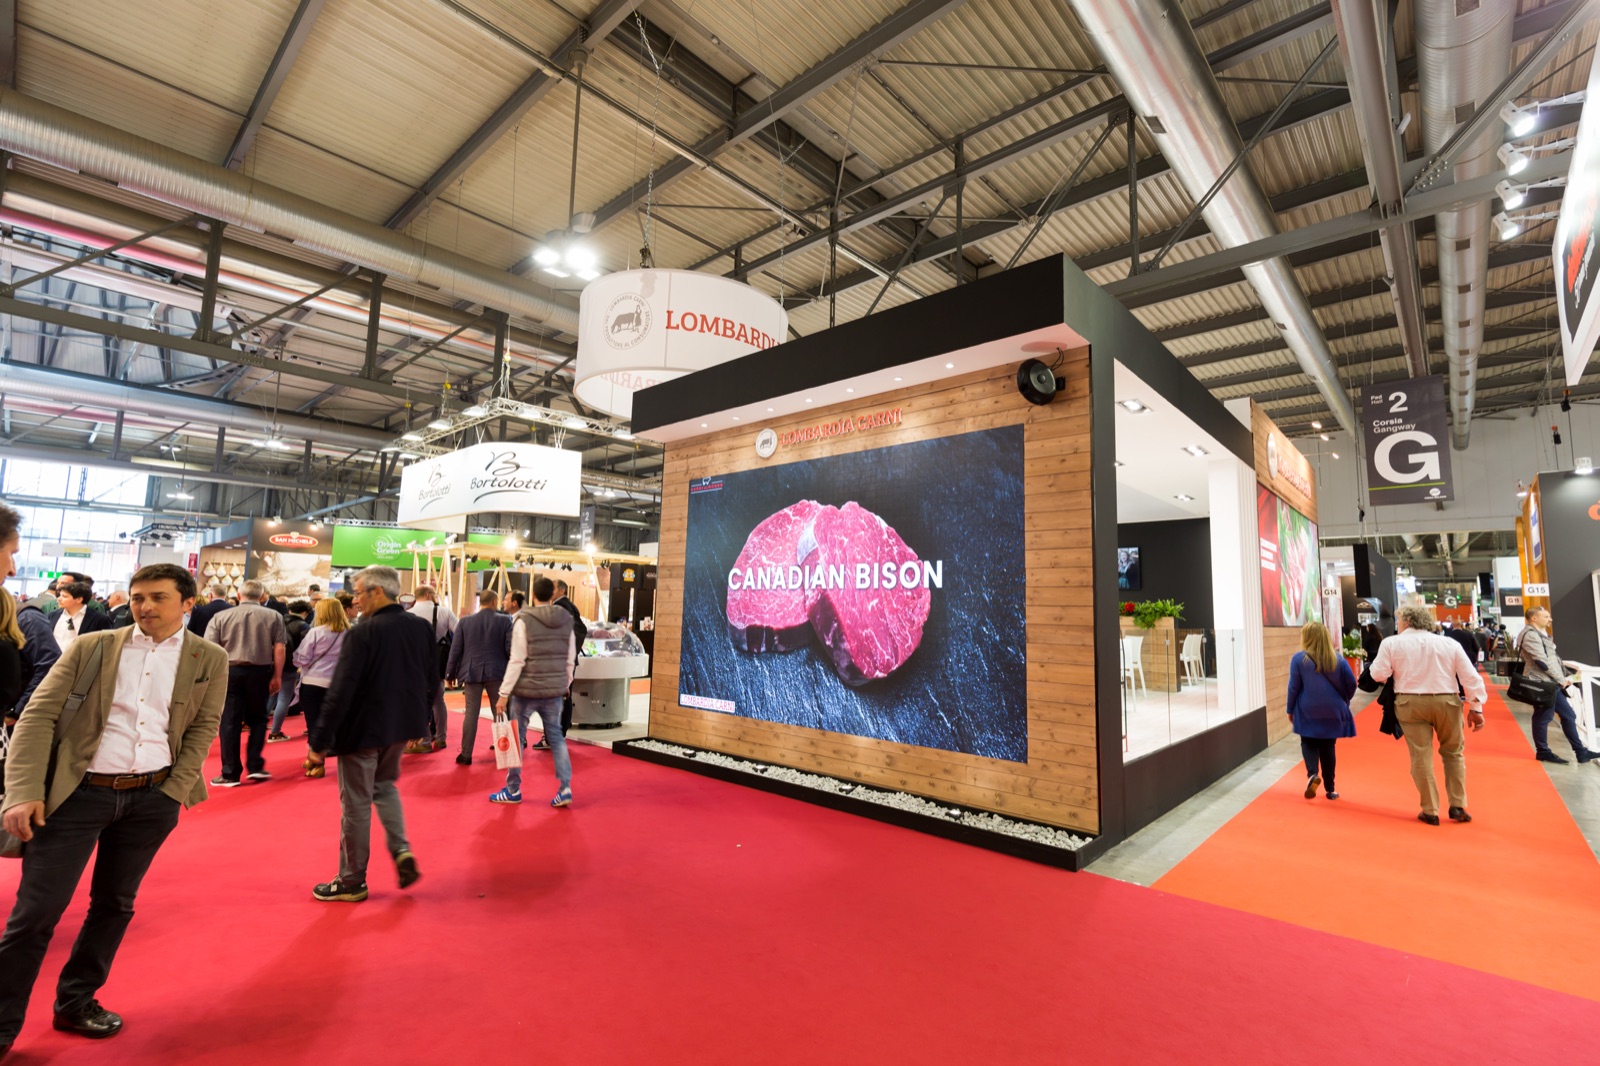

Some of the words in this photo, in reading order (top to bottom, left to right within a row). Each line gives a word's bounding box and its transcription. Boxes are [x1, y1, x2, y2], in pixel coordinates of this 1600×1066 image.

[665, 310, 781, 351] LOMBARDI
[1388, 391, 1408, 413] 2
[856, 408, 902, 431] CARNI
[1373, 417, 1403, 427] Corsia
[1373, 423, 1416, 434] Gangway
[1374, 430, 1441, 484] G
[470, 476, 548, 491] Bortolotti
[418, 482, 452, 501] Bortolotti
[585, 511, 590, 521] 2
[376, 547, 400, 555] Green
[377, 541, 401, 549] Origin
[728, 564, 845, 591] CANADIAN
[855, 560, 943, 590] BISON
[1445, 596, 1457, 606] G
[681, 695, 714, 708] LOMBARDIA
[716, 700, 734, 711] CARNI
